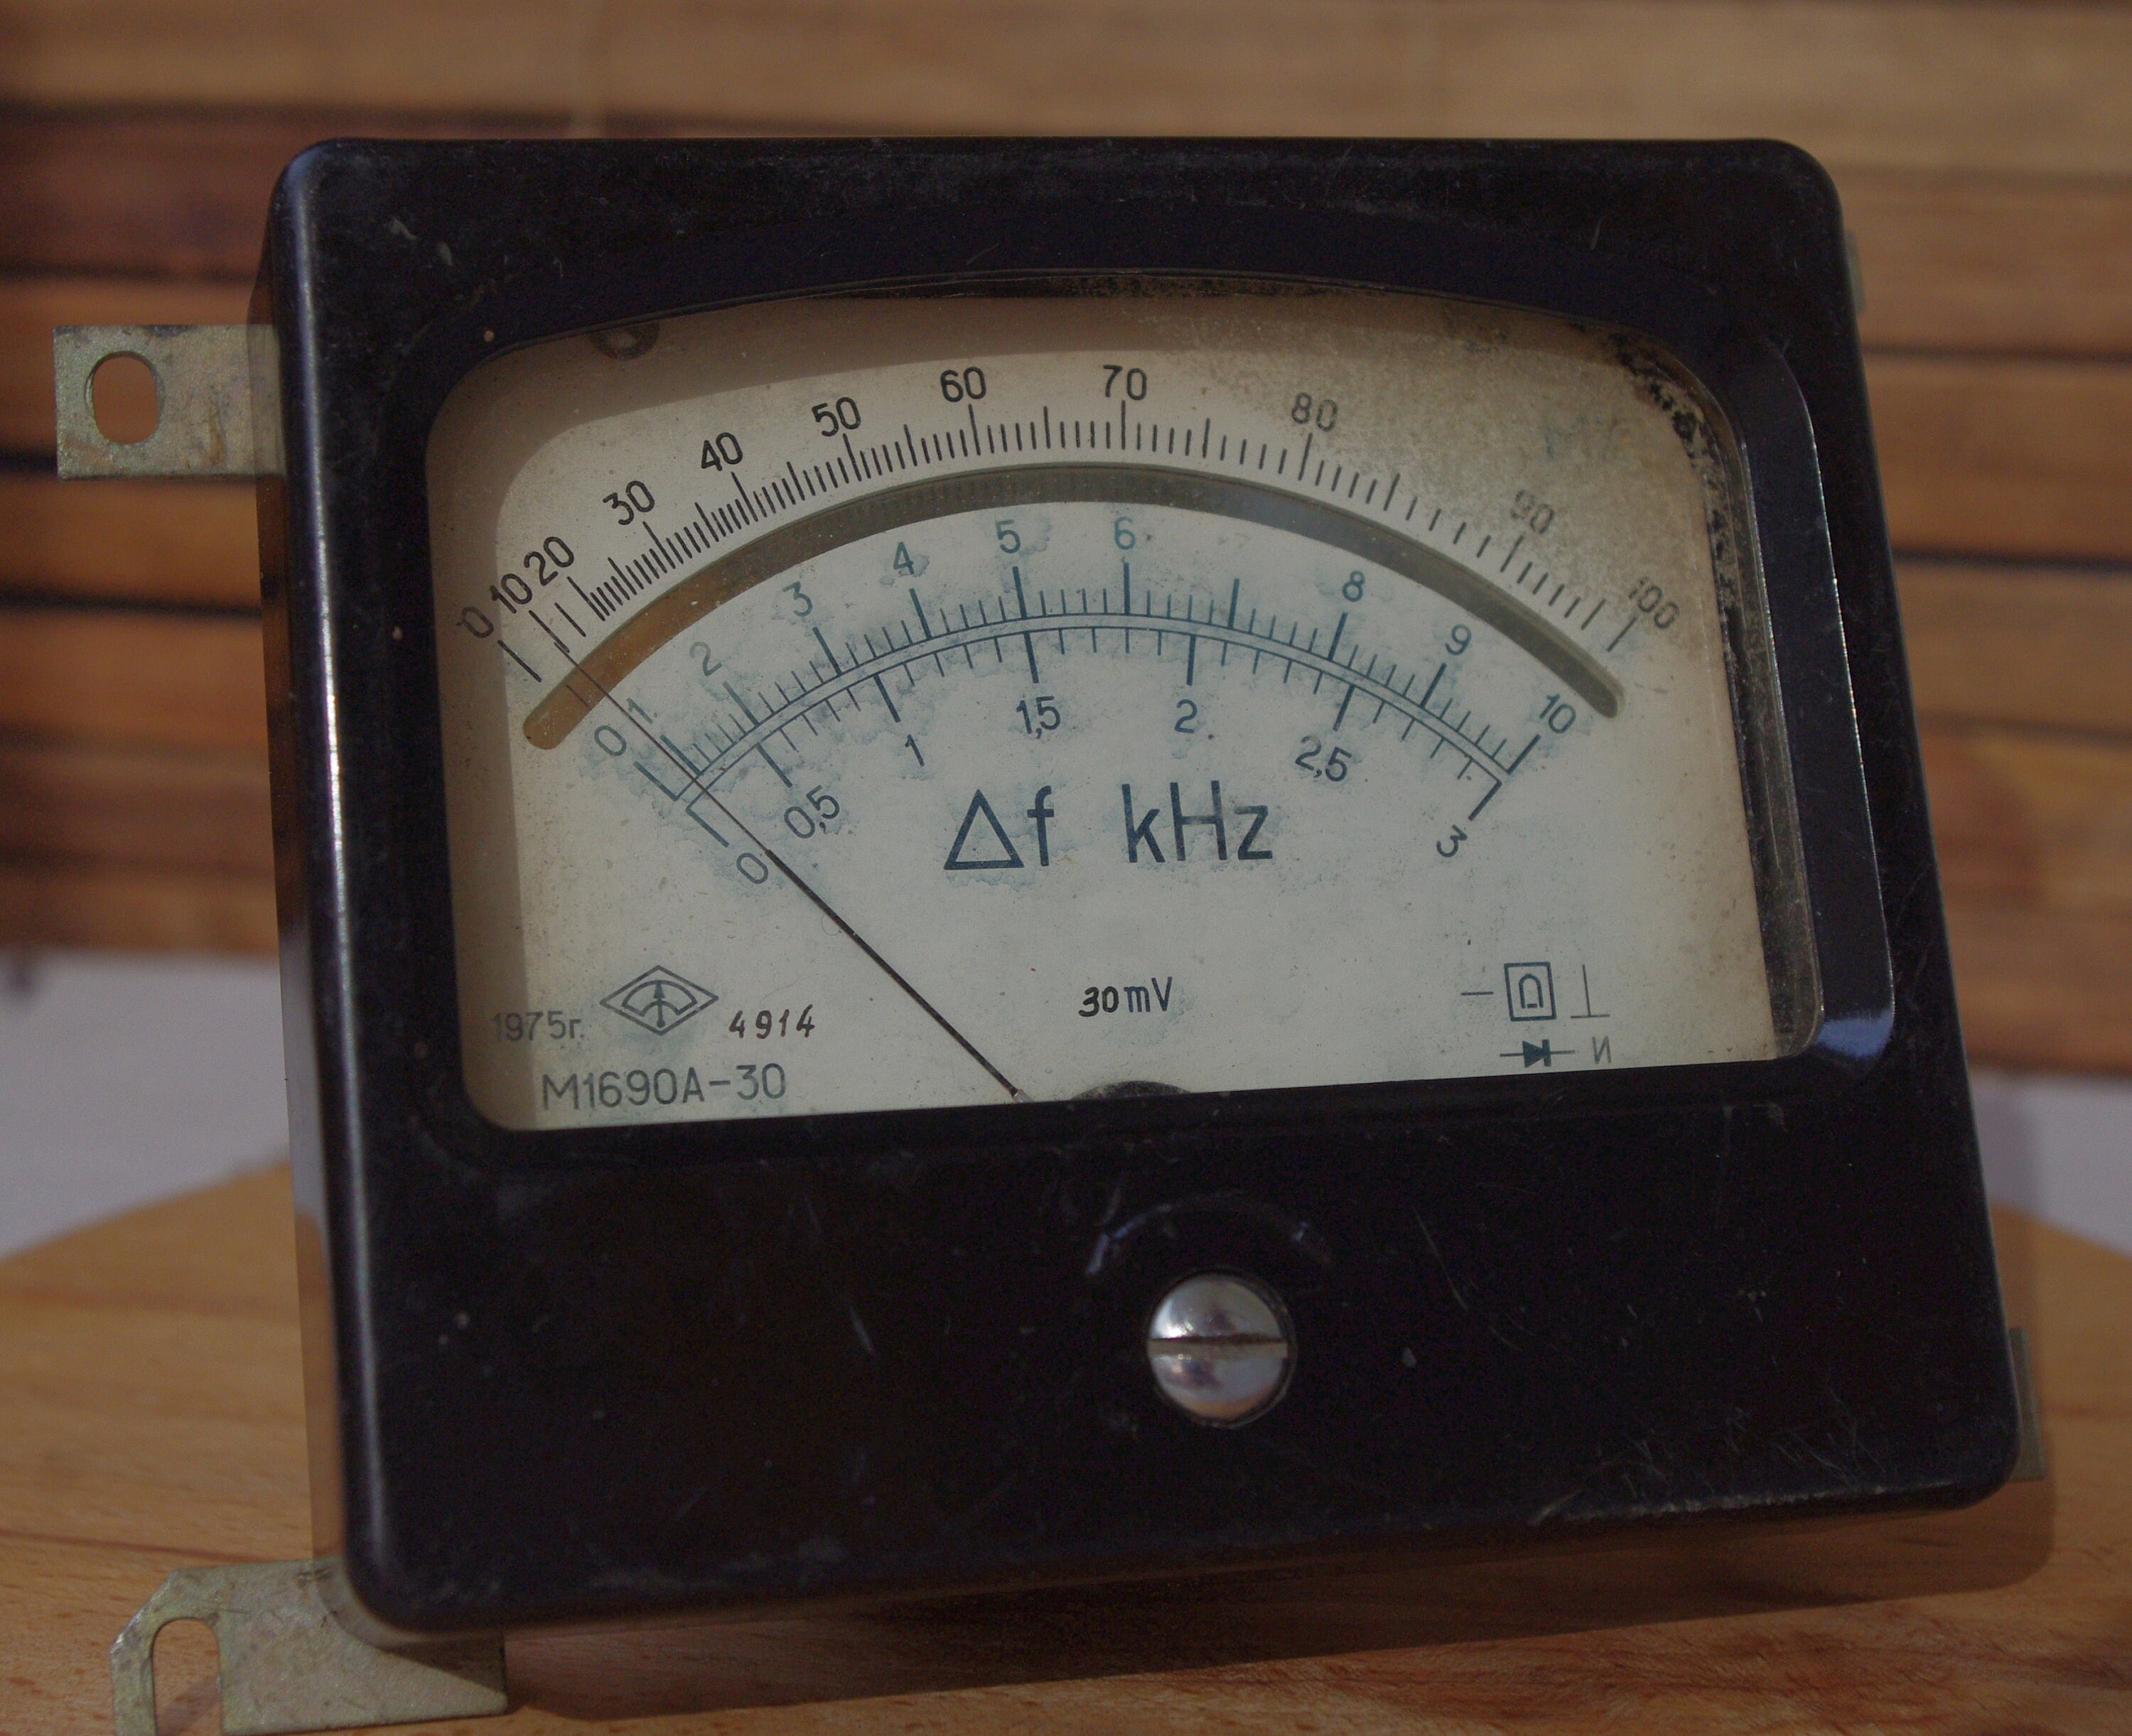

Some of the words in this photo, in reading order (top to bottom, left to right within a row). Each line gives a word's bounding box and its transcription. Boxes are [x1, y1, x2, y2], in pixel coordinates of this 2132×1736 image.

[461, 607, 495, 638] 0
[490, 573, 533, 613] 10
[523, 536, 575, 586] 20
[602, 480, 655, 526] 30
[700, 432, 743, 471] 40
[811, 397, 861, 436] 50
[940, 366, 987, 402] 60
[1102, 364, 1148, 401] 70
[1291, 392, 1339, 431] 80
[1509, 488, 1556, 535] 90
[1628, 576, 1680, 630] 100
[593, 724, 627, 756] 0
[627, 697, 653, 723] 1
[689, 641, 722, 676] 2
[782, 581, 813, 617] 3
[891, 541, 915, 575] 4
[996, 519, 1022, 554] 5
[1114, 516, 1136, 550] 6
[1342, 570, 1366, 603] 8
[1445, 624, 1473, 656] 9
[1539, 694, 1577, 734] 10
[736, 852, 769, 884] 0
[905, 734, 925, 767] 1
[1174, 699, 1199, 734] 2
[1435, 825, 1468, 858] 3
[1121, 780, 1274, 864] kHz
[728, 1004, 816, 1039] 4914
